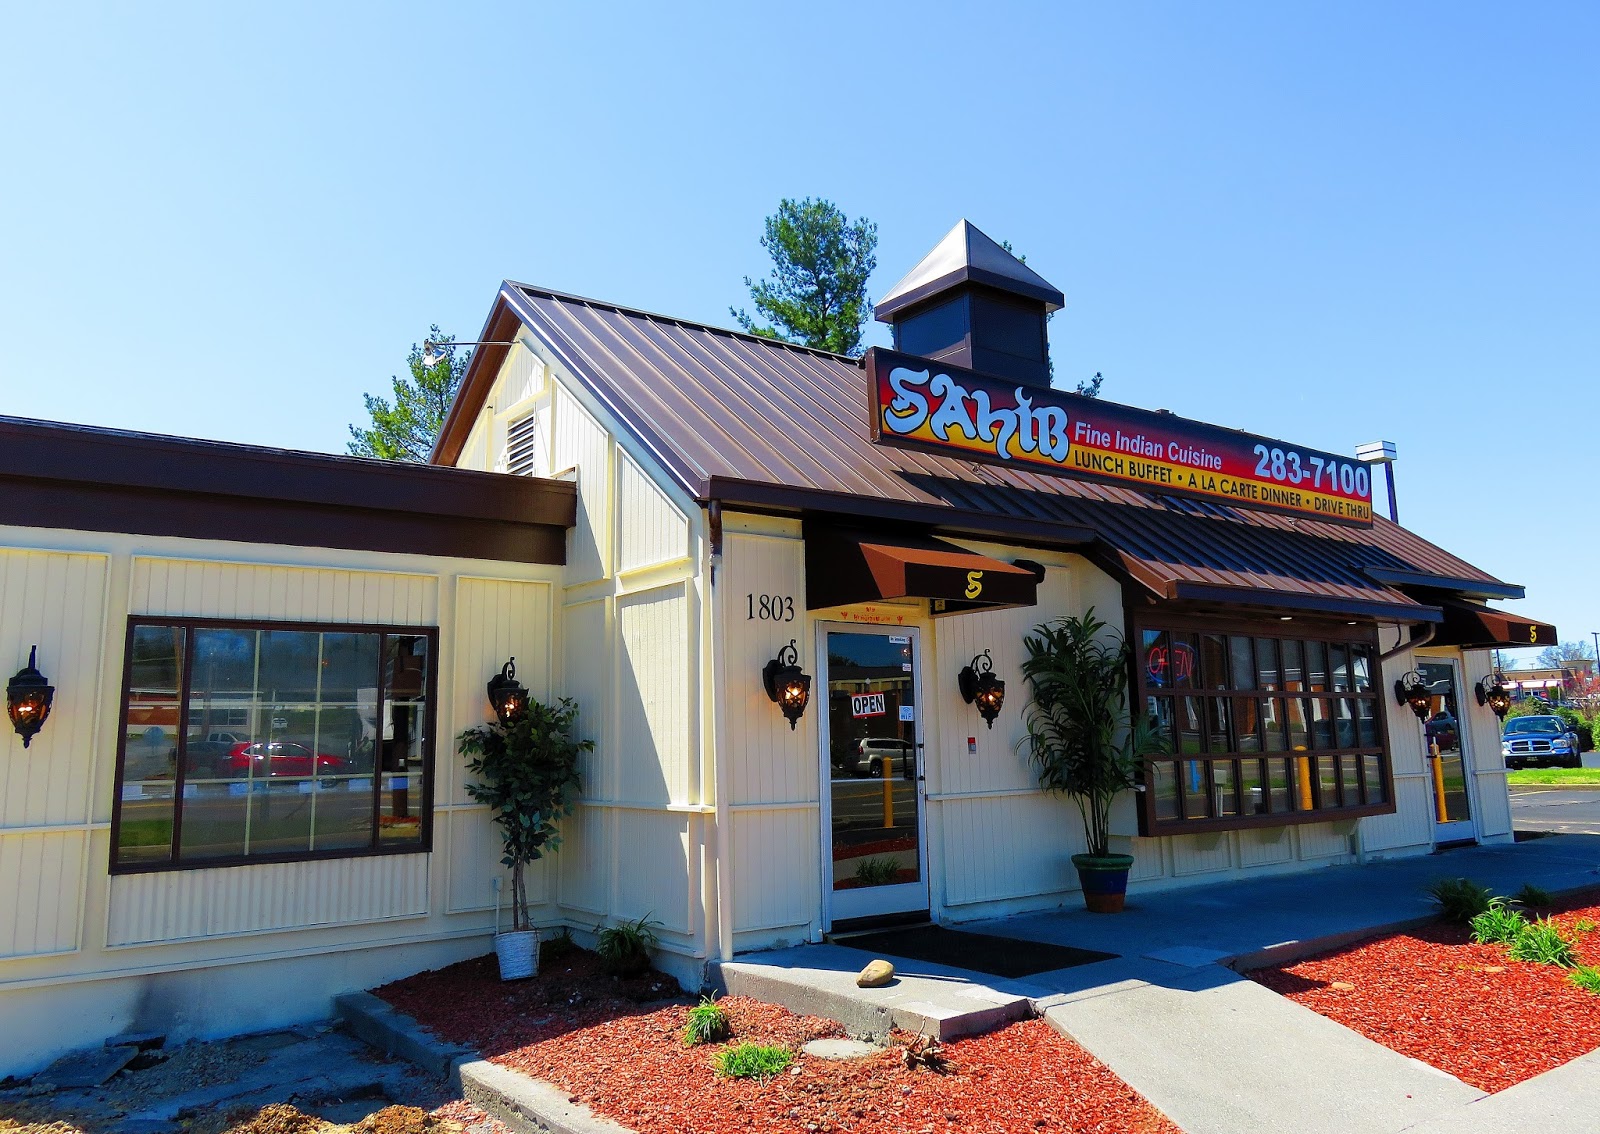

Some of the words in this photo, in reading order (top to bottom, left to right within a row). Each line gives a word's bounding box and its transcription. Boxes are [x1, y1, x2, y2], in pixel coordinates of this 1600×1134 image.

[1074, 421, 1111, 448] Fine
[1115, 430, 1163, 459] Indian
[1168, 441, 1222, 470] Cuisine
[1074, 449, 1124, 475] LUNCH
[1128, 460, 1172, 483] BUFFET
[1188, 473, 1198, 489] A
[1201, 475, 1217, 492] LA
[1220, 479, 1258, 500] CARTE
[1261, 486, 1302, 508] DINNER
[1314, 496, 1344, 515] DRIVE
[1345, 502, 1370, 520] THRU
[1253, 444, 1369, 498] 283-7100
[746, 593, 795, 622] 1803
[853, 694, 884, 714] OPEN
